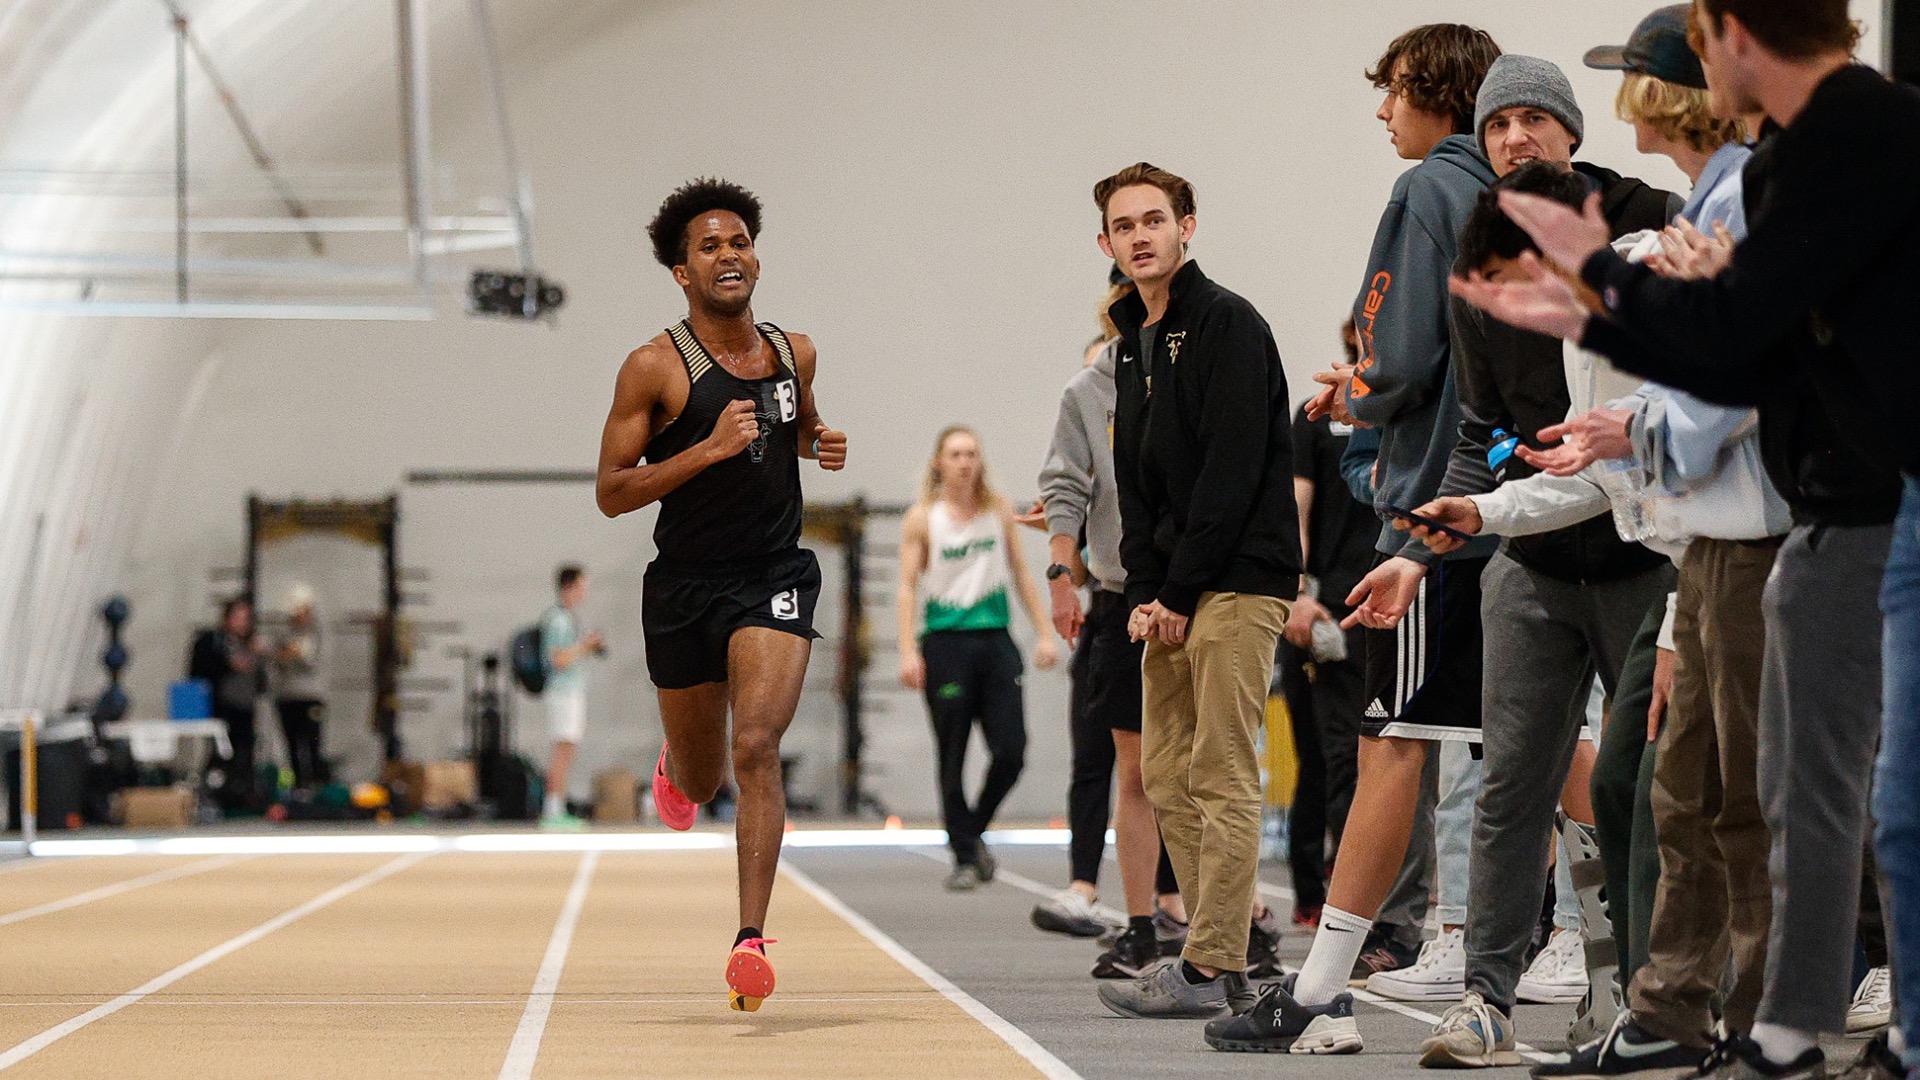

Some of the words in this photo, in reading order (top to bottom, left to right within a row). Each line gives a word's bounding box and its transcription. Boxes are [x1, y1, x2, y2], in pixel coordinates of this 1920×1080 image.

[782, 382, 795, 419] 3
[779, 590, 796, 615] 3
[1364, 710, 1389, 718] adidas
